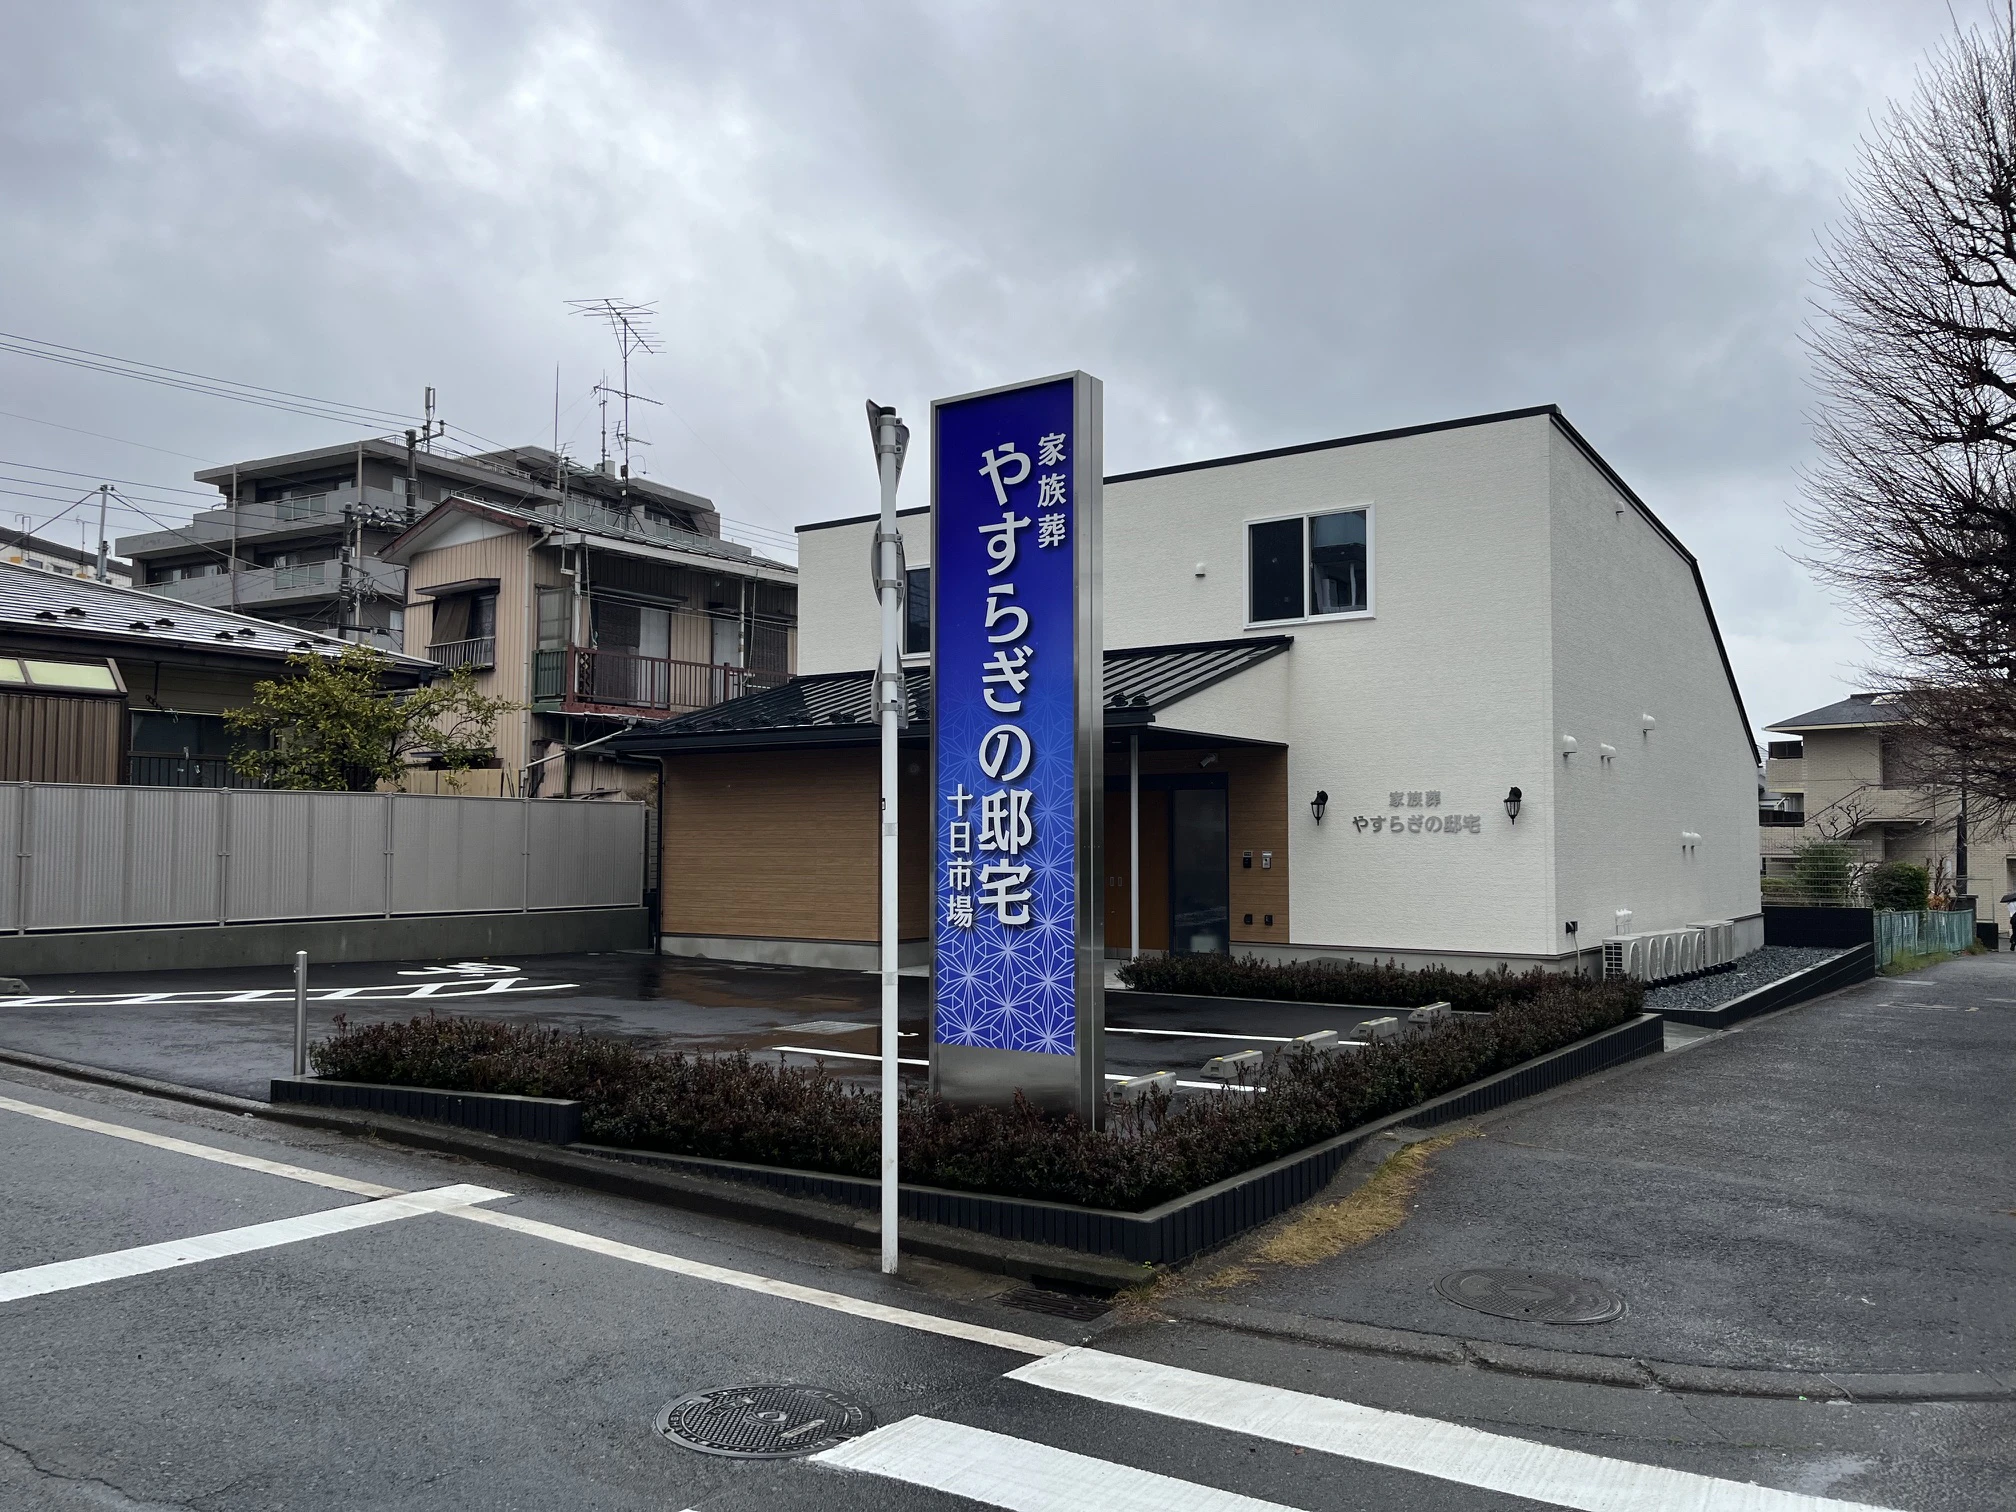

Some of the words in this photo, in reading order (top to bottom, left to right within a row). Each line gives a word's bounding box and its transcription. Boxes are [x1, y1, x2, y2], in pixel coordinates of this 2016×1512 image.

[1037, 433, 1067, 548] 家族葬
[978, 442, 1033, 925] やすらぎの邸宅
[947, 784, 973, 928] 十日市場
[1352, 814, 1481, 833] やすらぎの邸宅
[1389, 790, 1441, 807] 家族葬
